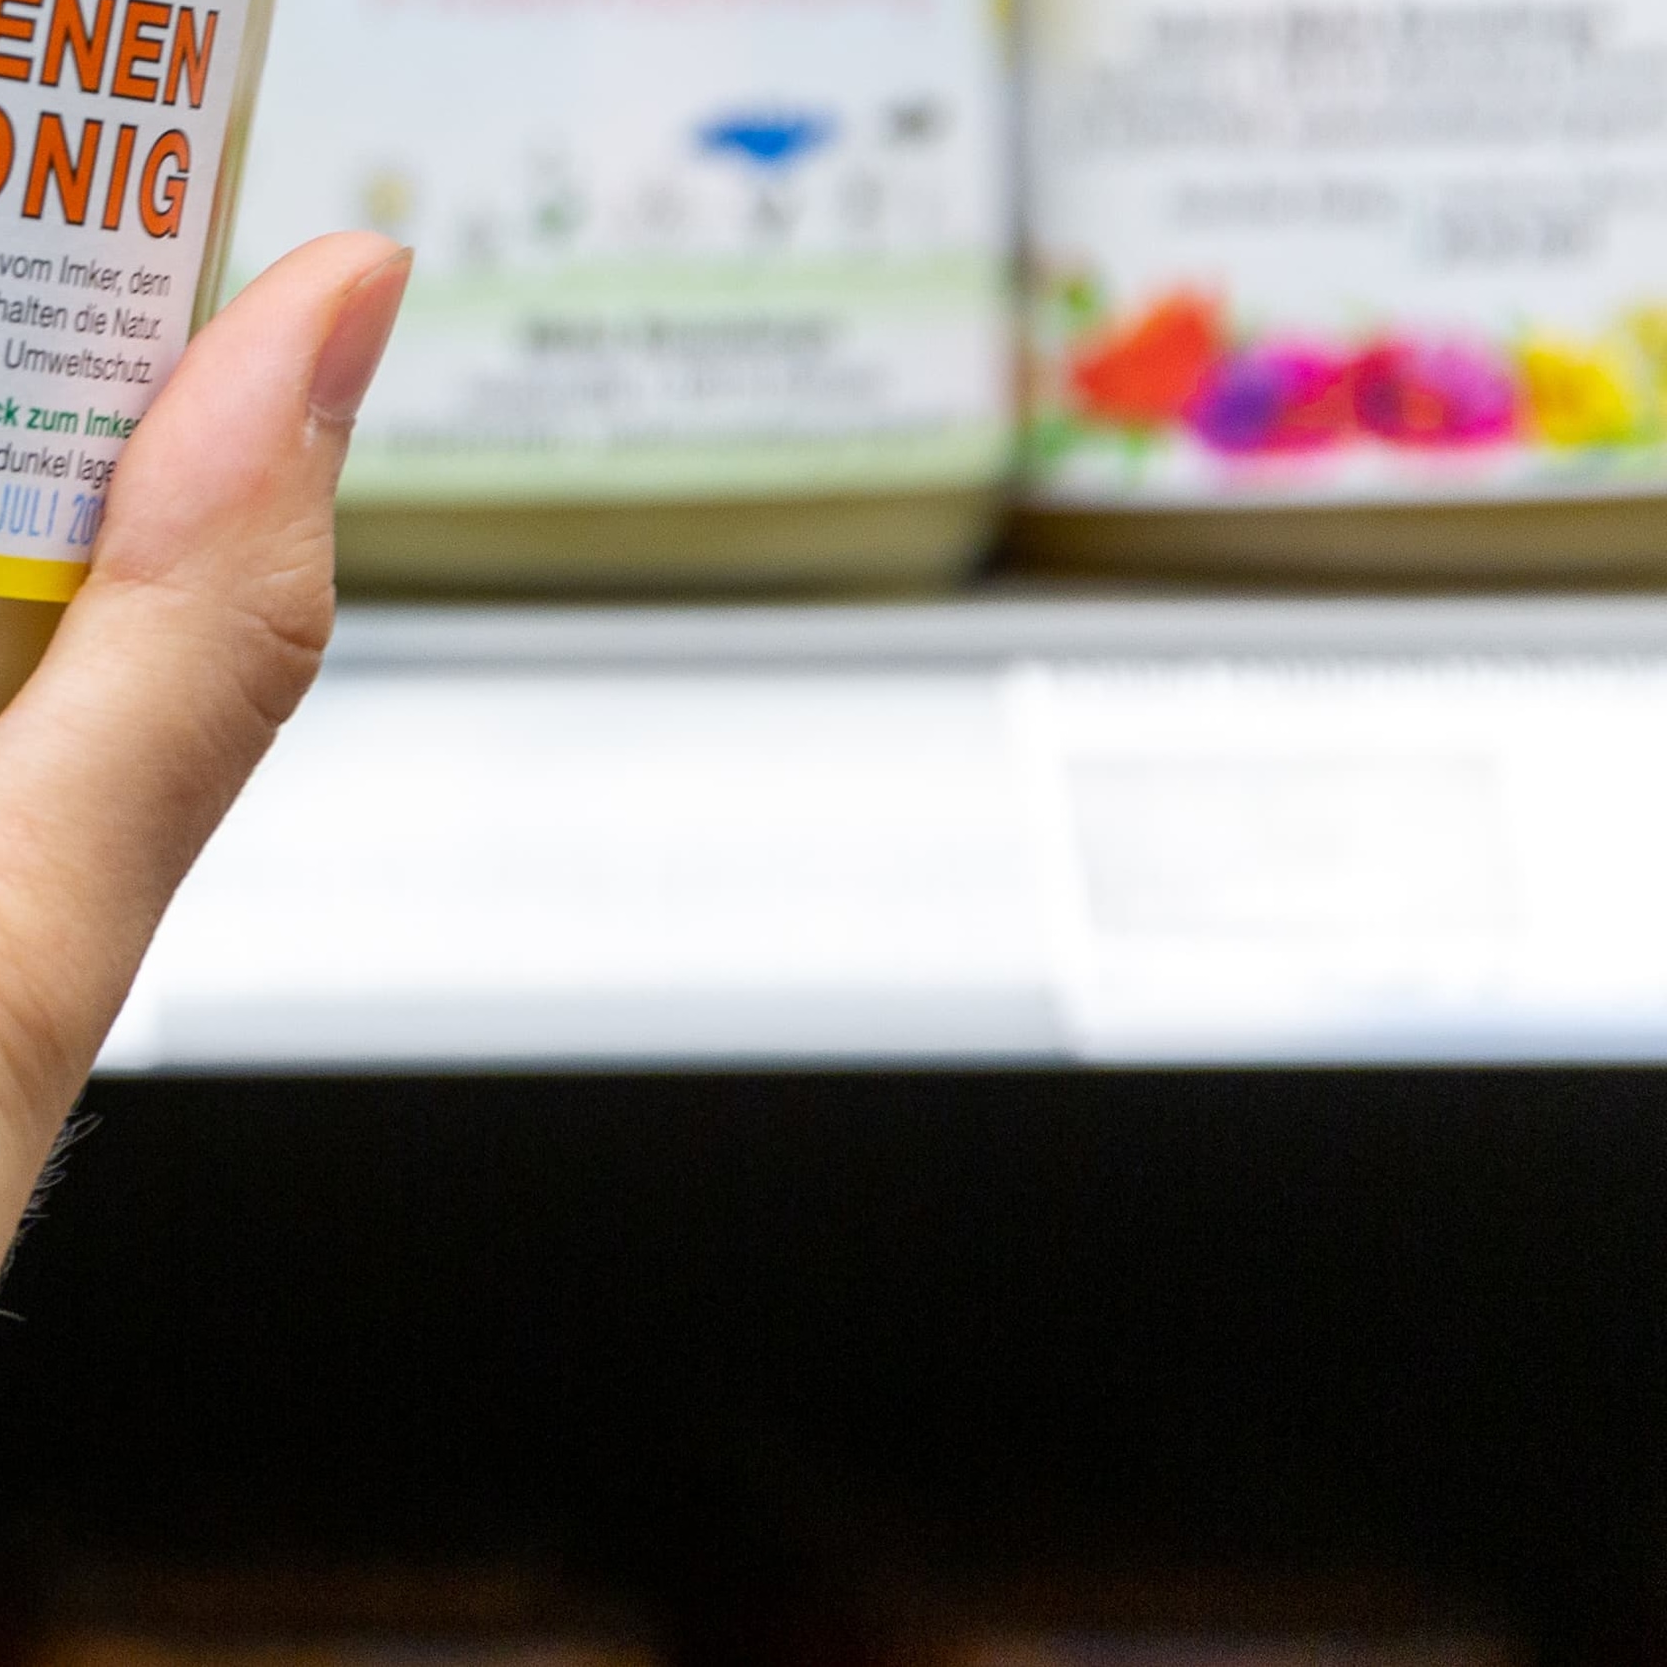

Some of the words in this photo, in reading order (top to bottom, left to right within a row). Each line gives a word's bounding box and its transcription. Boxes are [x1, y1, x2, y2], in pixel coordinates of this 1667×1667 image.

[59, 259, 123, 298] Imker,
[129, 267, 170, 298] denn
[74, 301, 109, 335] die
[27, 405, 81, 435] zum
